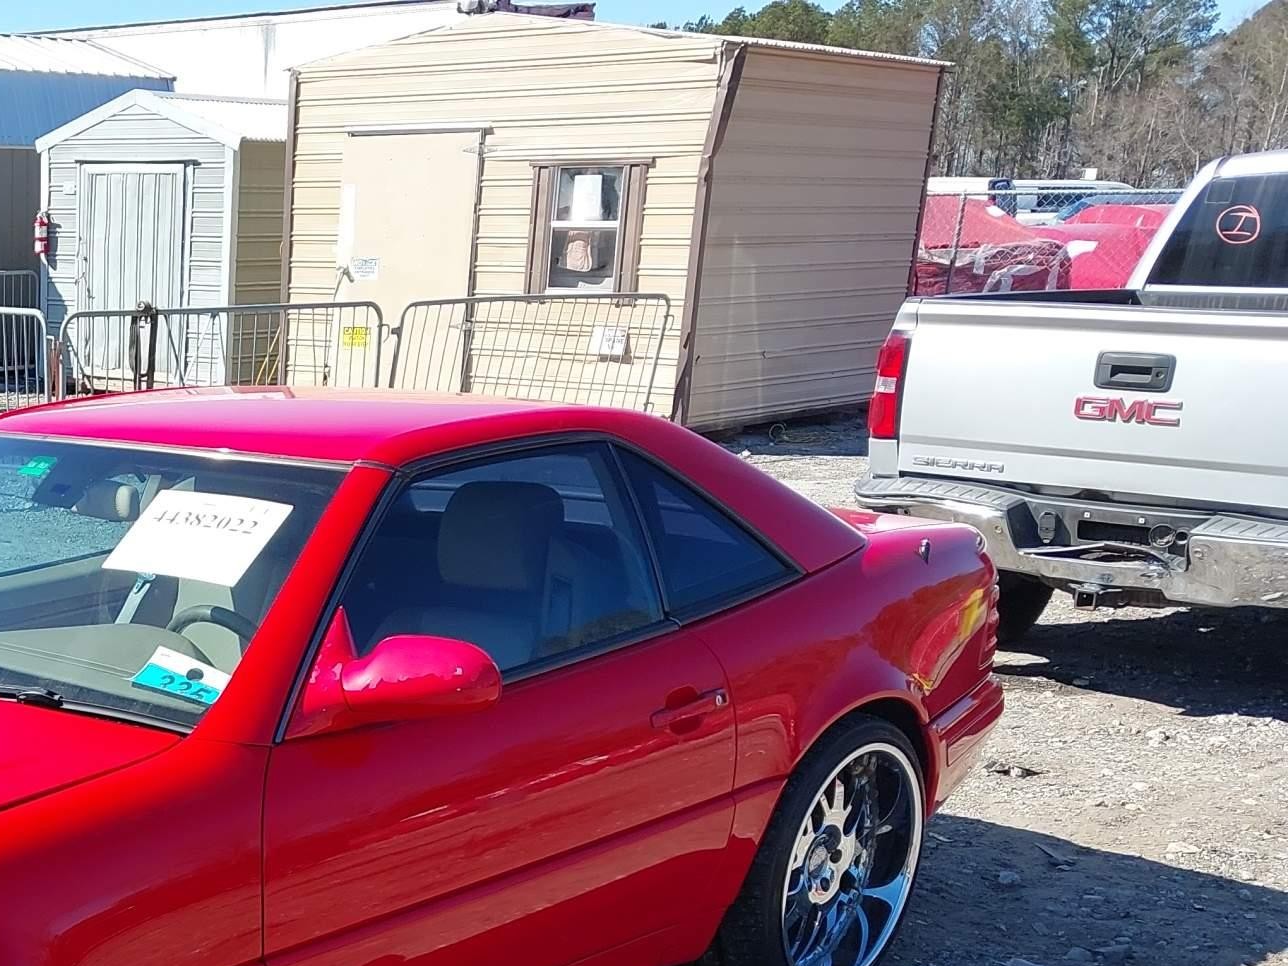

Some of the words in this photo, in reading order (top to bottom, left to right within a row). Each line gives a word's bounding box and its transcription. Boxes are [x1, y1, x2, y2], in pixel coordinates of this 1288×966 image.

[1074, 396, 1183, 427] GMC
[912, 456, 1005, 474] SIERRA
[152, 509, 259, 535] 44382022
